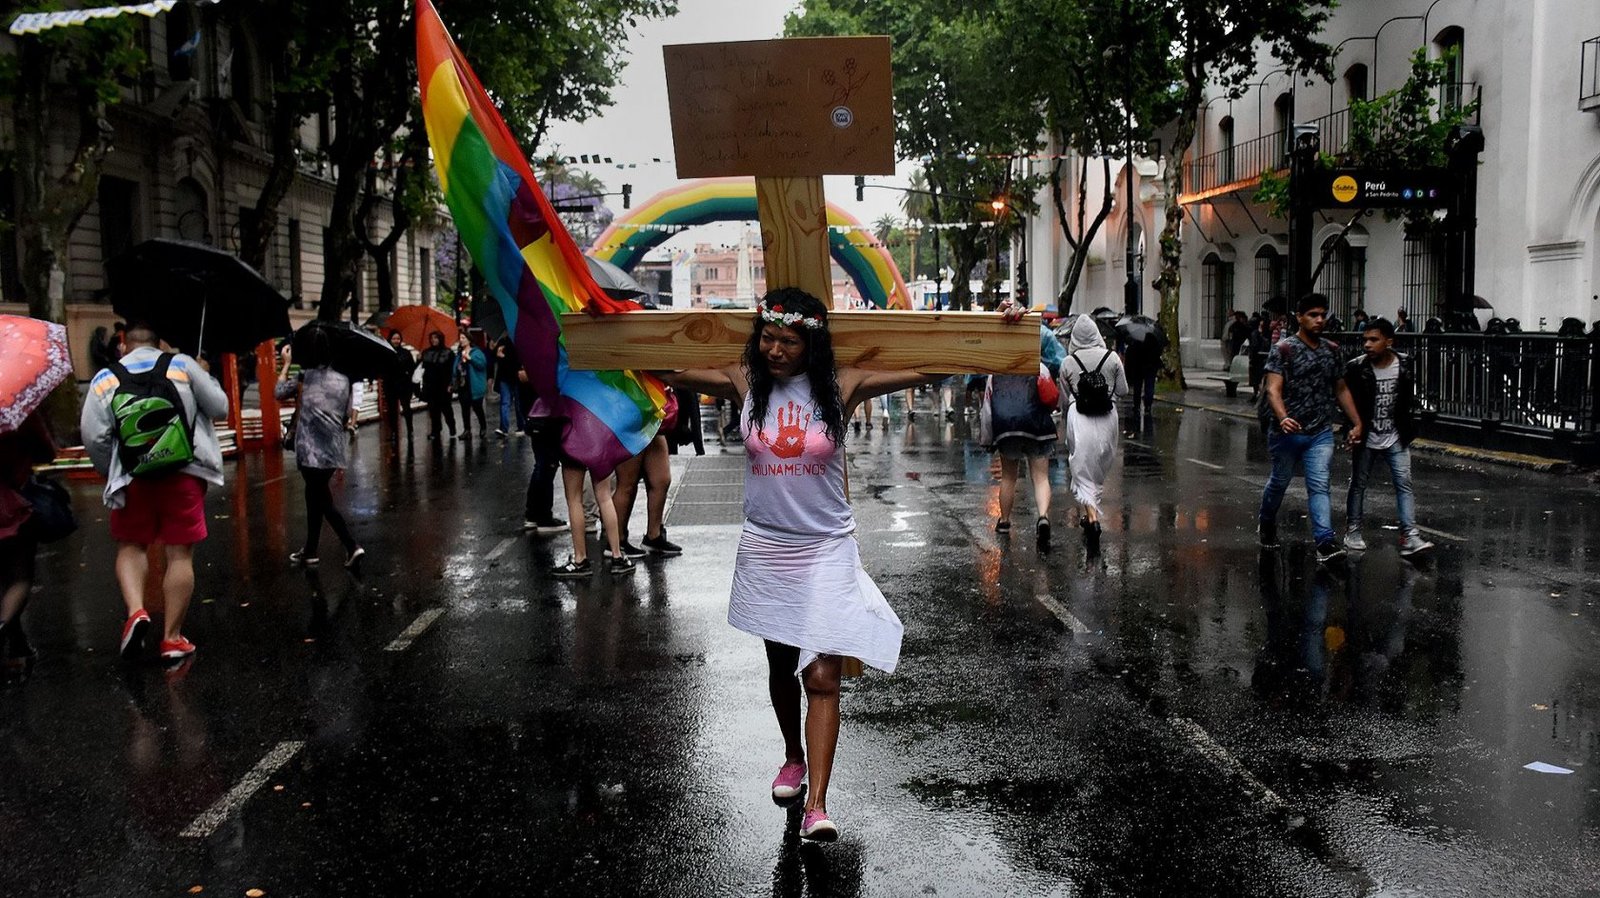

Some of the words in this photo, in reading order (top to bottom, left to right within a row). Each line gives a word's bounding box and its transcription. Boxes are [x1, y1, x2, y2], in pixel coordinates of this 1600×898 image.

[1365, 181, 1386, 190] Perú
[1416, 190, 1423, 198] D
[1429, 189, 1435, 198] E
